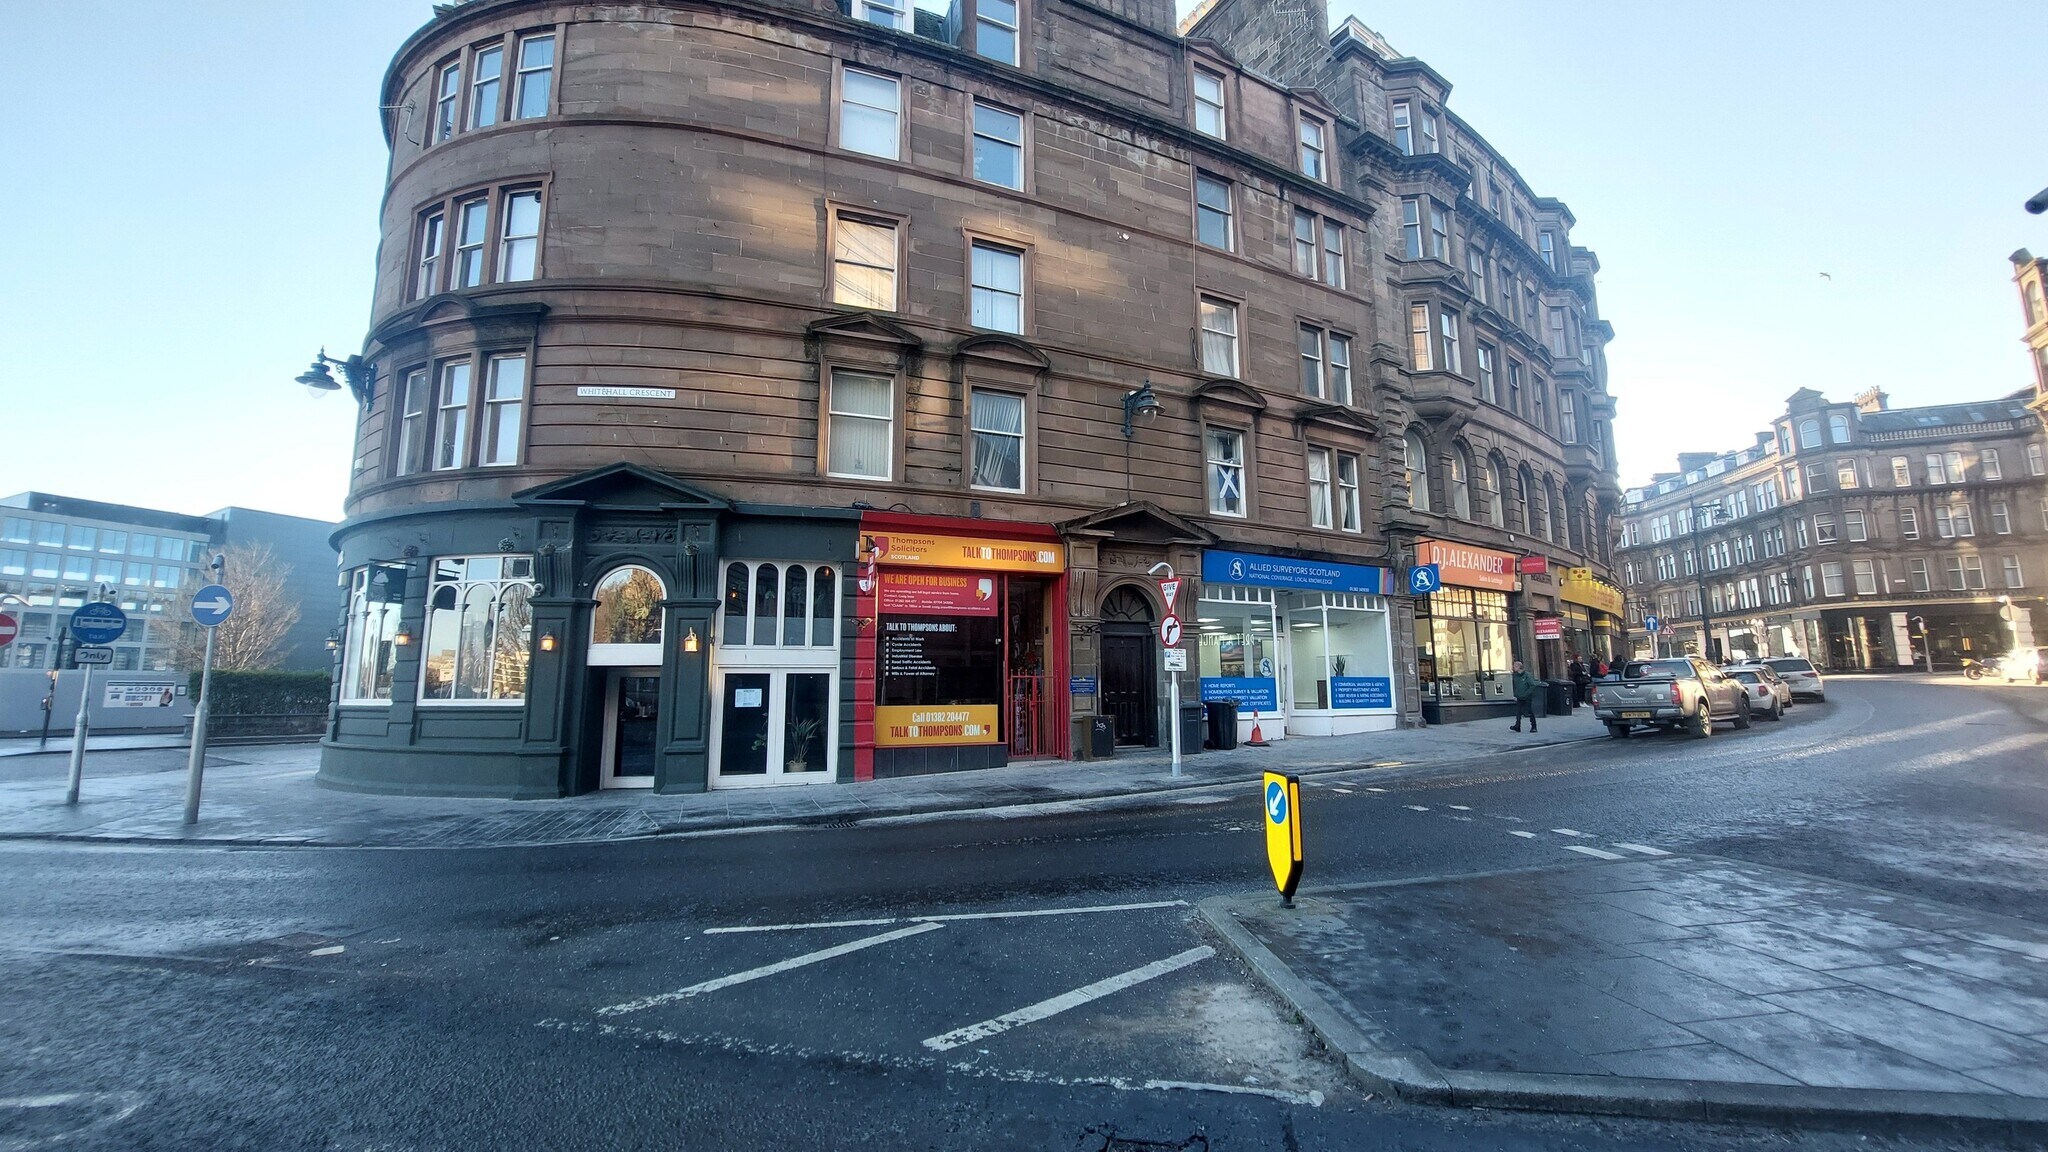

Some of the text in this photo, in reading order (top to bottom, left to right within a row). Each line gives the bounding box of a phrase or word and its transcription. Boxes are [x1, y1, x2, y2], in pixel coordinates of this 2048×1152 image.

[580, 388, 672, 398] WHITEHALL CRESCENT
[891, 536, 936, 546] Thompsons
[962, 546, 1055, 564] TALKTOTHOMPSONS.COM
[1250, 562, 1340, 578] ALLIED SURVEYORS SCOTLAND
[884, 574, 968, 588] WE ARE OPEN FOR BUSINESS
[1163, 583, 1176, 591] GIVE
[886, 622, 958, 632] TALK TO THOMPSONS ABOUT:
[80, 651, 107, 660] Only
[912, 712, 969, 723] Call 01382 204477
[890, 724, 980, 738] TALKTOTHOMPSONS.COM
